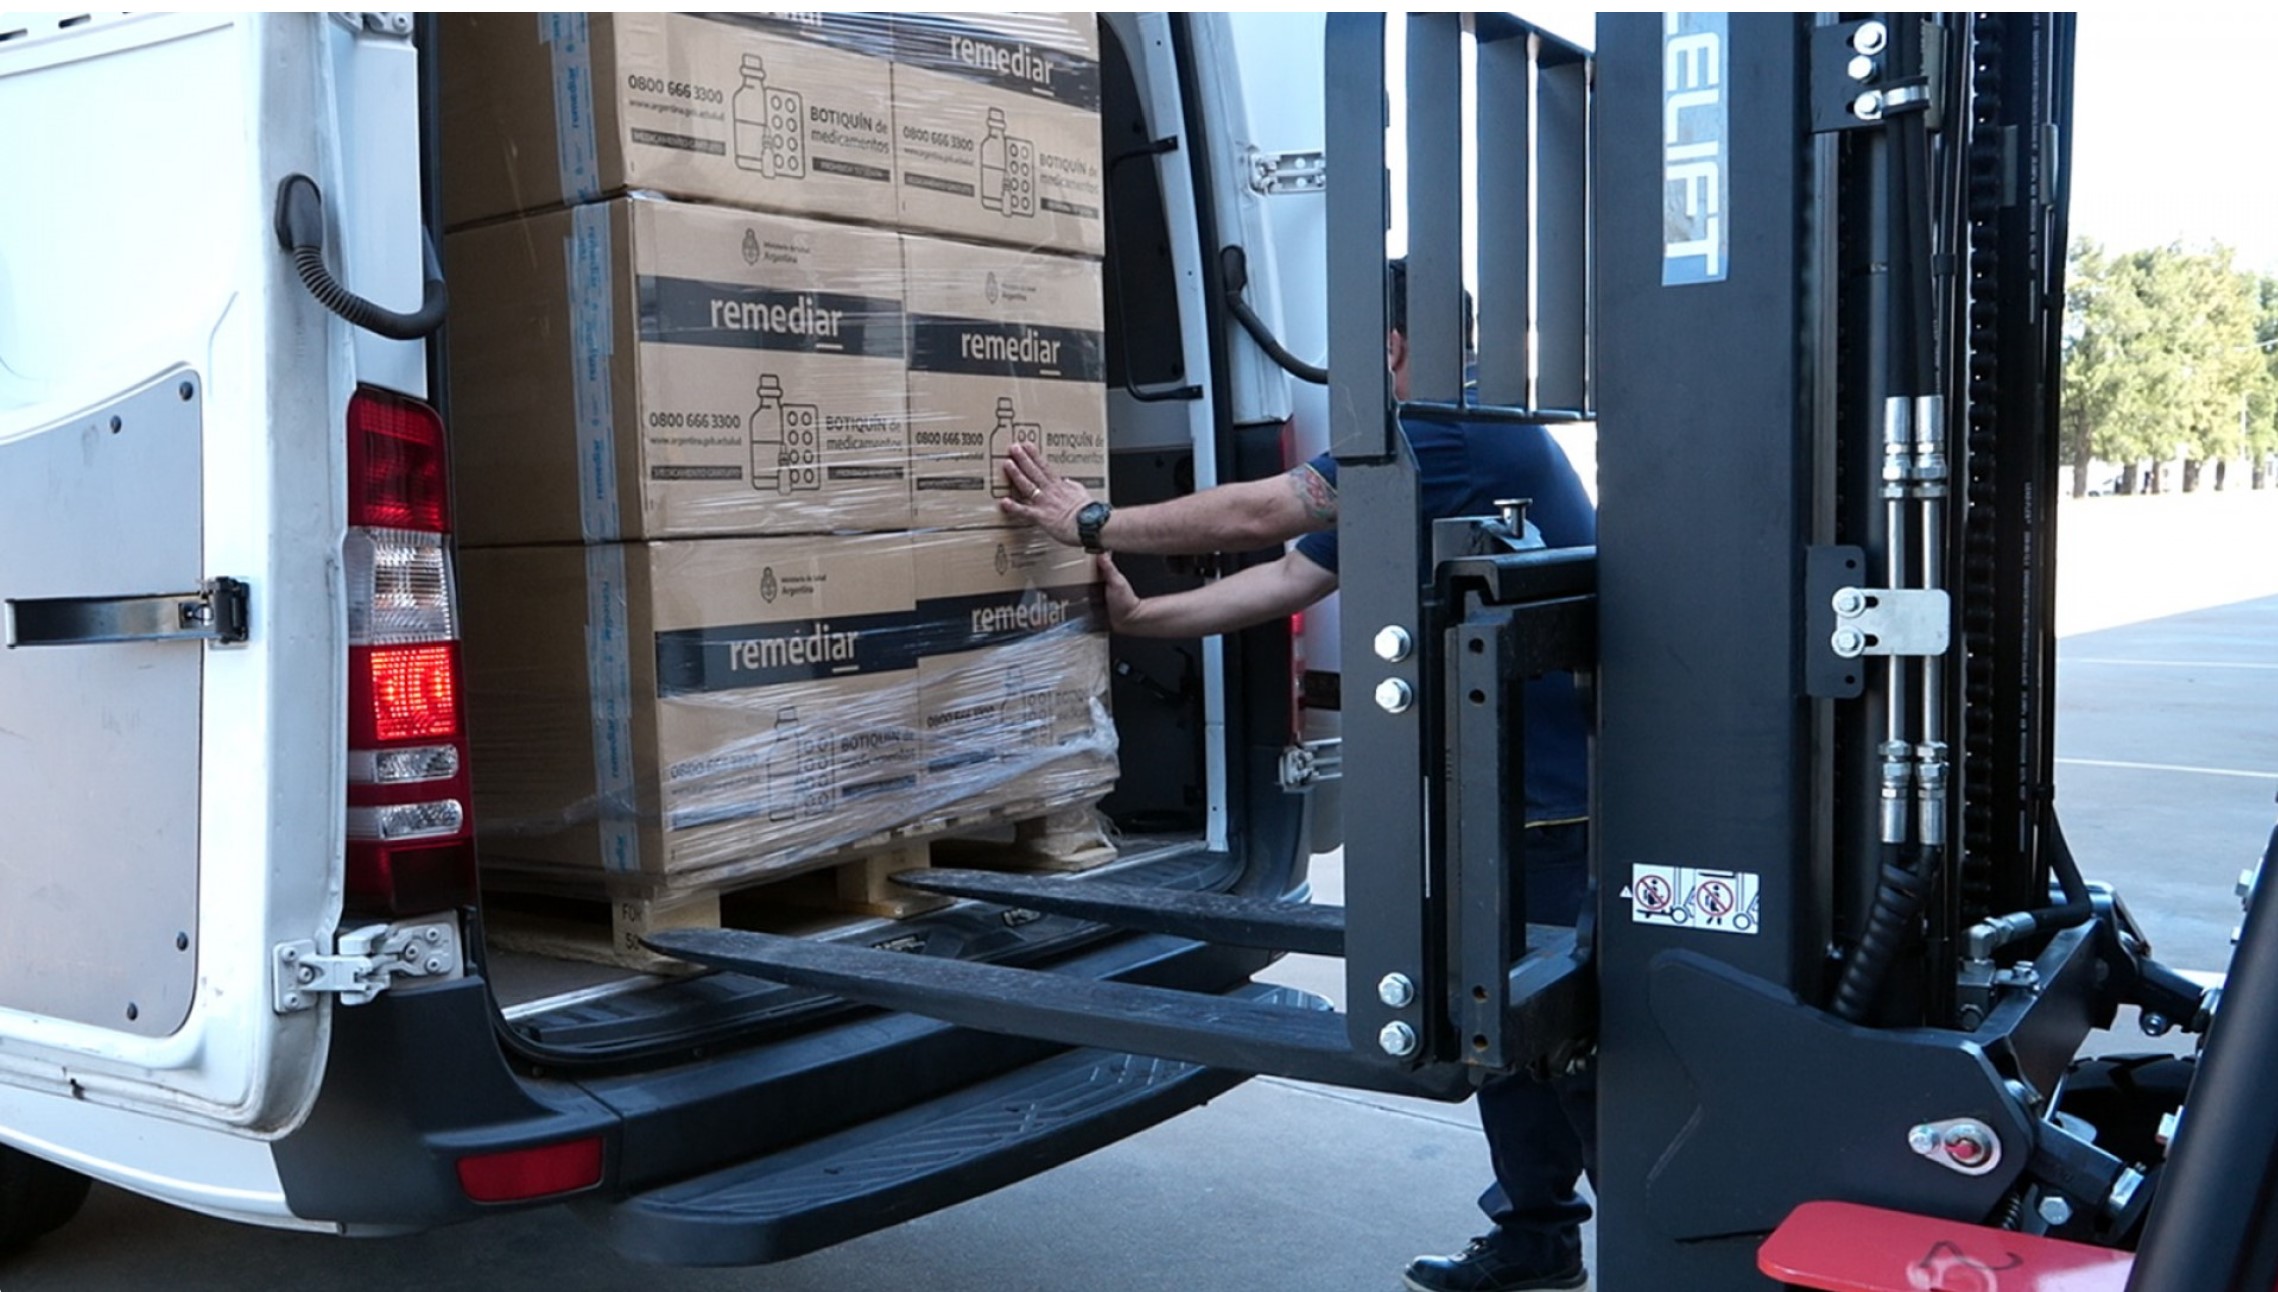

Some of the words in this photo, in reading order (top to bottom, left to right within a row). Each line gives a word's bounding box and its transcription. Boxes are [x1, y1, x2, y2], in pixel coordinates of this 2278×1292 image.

[950, 35, 1054, 85] remediar
[628, 75, 665, 94] 0800
[667, 81, 691, 99] 666
[693, 85, 723, 104] 3300
[810, 105, 872, 132] BOTIQUÍN
[875, 119, 888, 134] de
[903, 126, 929, 142] 0800
[931, 131, 949, 147] 666
[951, 134, 974, 152] 3300
[1666, 12, 1720, 276] ELIFT
[710, 295, 842, 337] remediar
[961, 328, 1060, 364] remediar
[649, 412, 684, 428] 0800
[686, 412, 709, 428] 666
[711, 413, 742, 429] 3300
[826, 413, 887, 433] BOTIQUÍN
[916, 432, 941, 445] 0800
[942, 432, 960, 445] 666
[961, 432, 984, 446] 3300
[972, 591, 1069, 633] remediar
[730, 623, 858, 671] remediar
